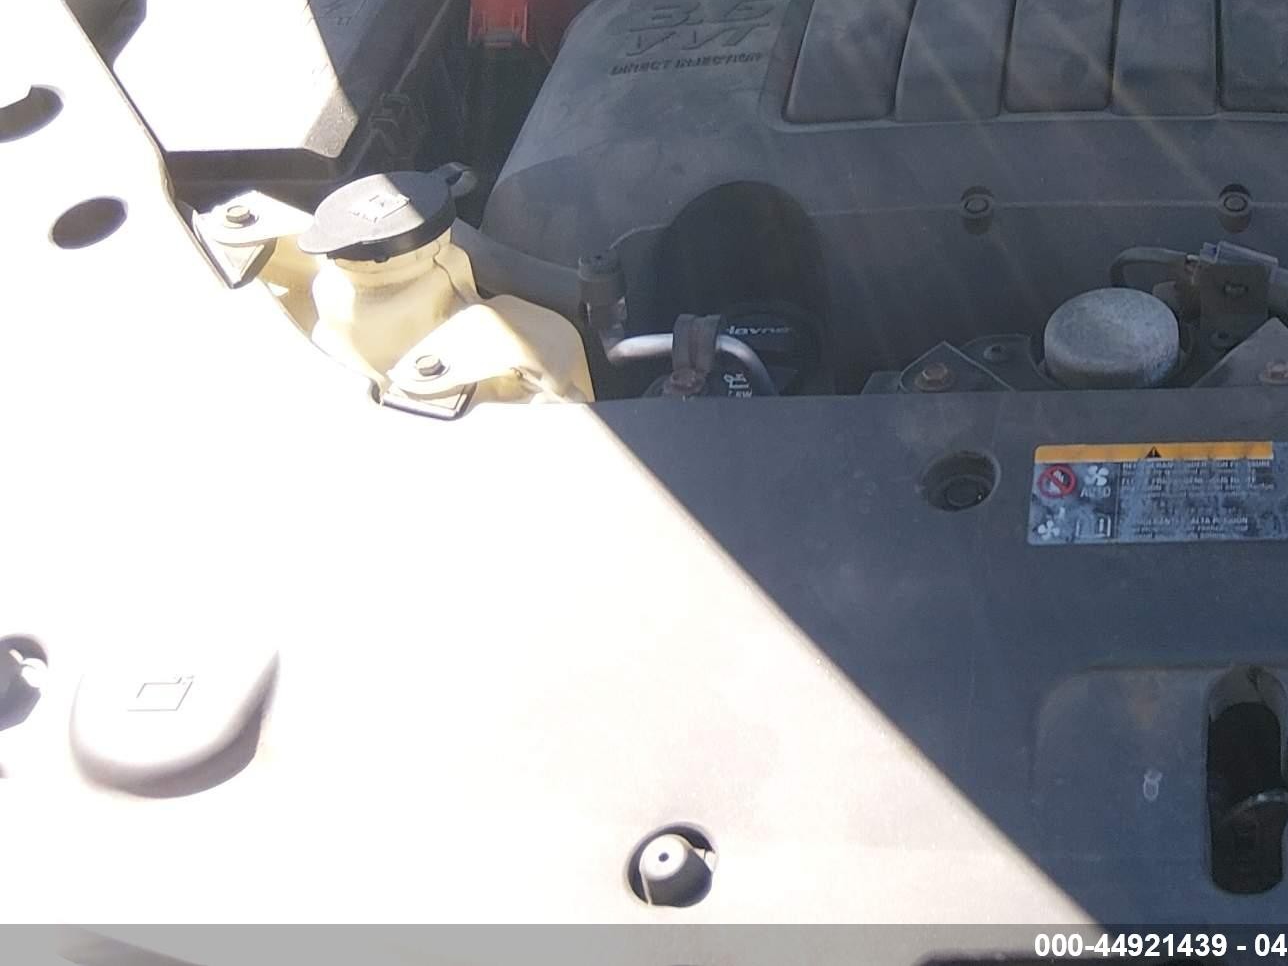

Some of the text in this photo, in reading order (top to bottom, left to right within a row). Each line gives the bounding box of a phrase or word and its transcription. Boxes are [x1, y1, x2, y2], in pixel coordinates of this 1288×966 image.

[626, 21, 772, 57] VVT
[610, 51, 763, 75] DIRECT INJECTION
